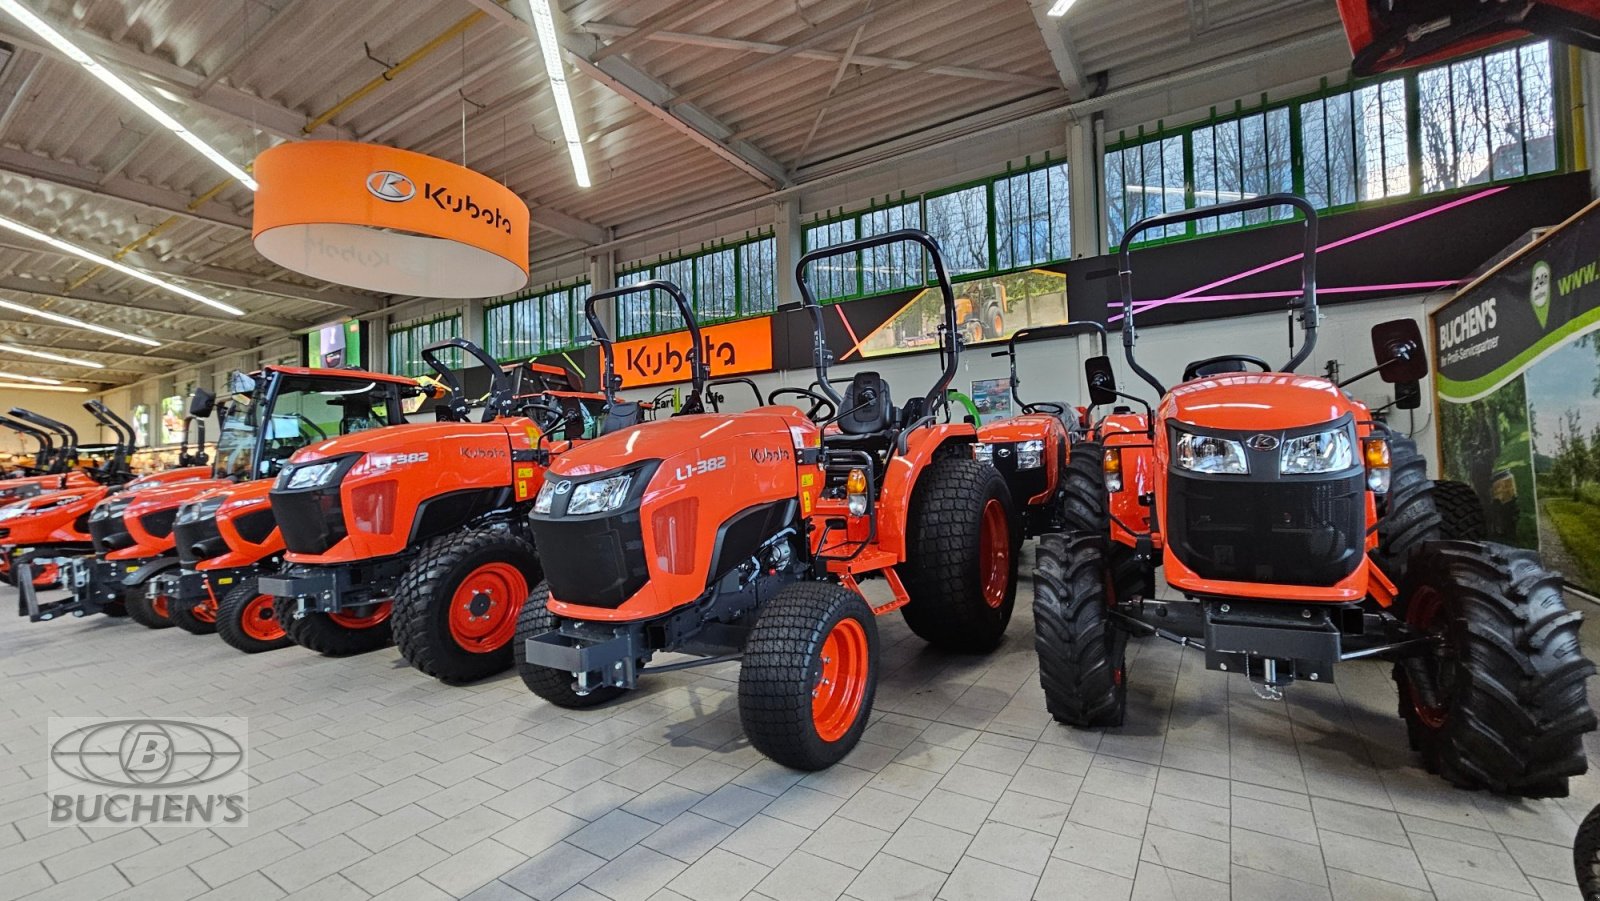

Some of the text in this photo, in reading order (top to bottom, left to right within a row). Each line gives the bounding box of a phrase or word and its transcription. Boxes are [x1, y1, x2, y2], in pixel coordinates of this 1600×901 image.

[424, 183, 512, 235] Kubota
[1440, 297, 1497, 351] BUCHEN'S
[461, 447, 506, 459] Kubota
[751, 448, 789, 463] Kubota
[675, 455, 726, 481] L1-382
